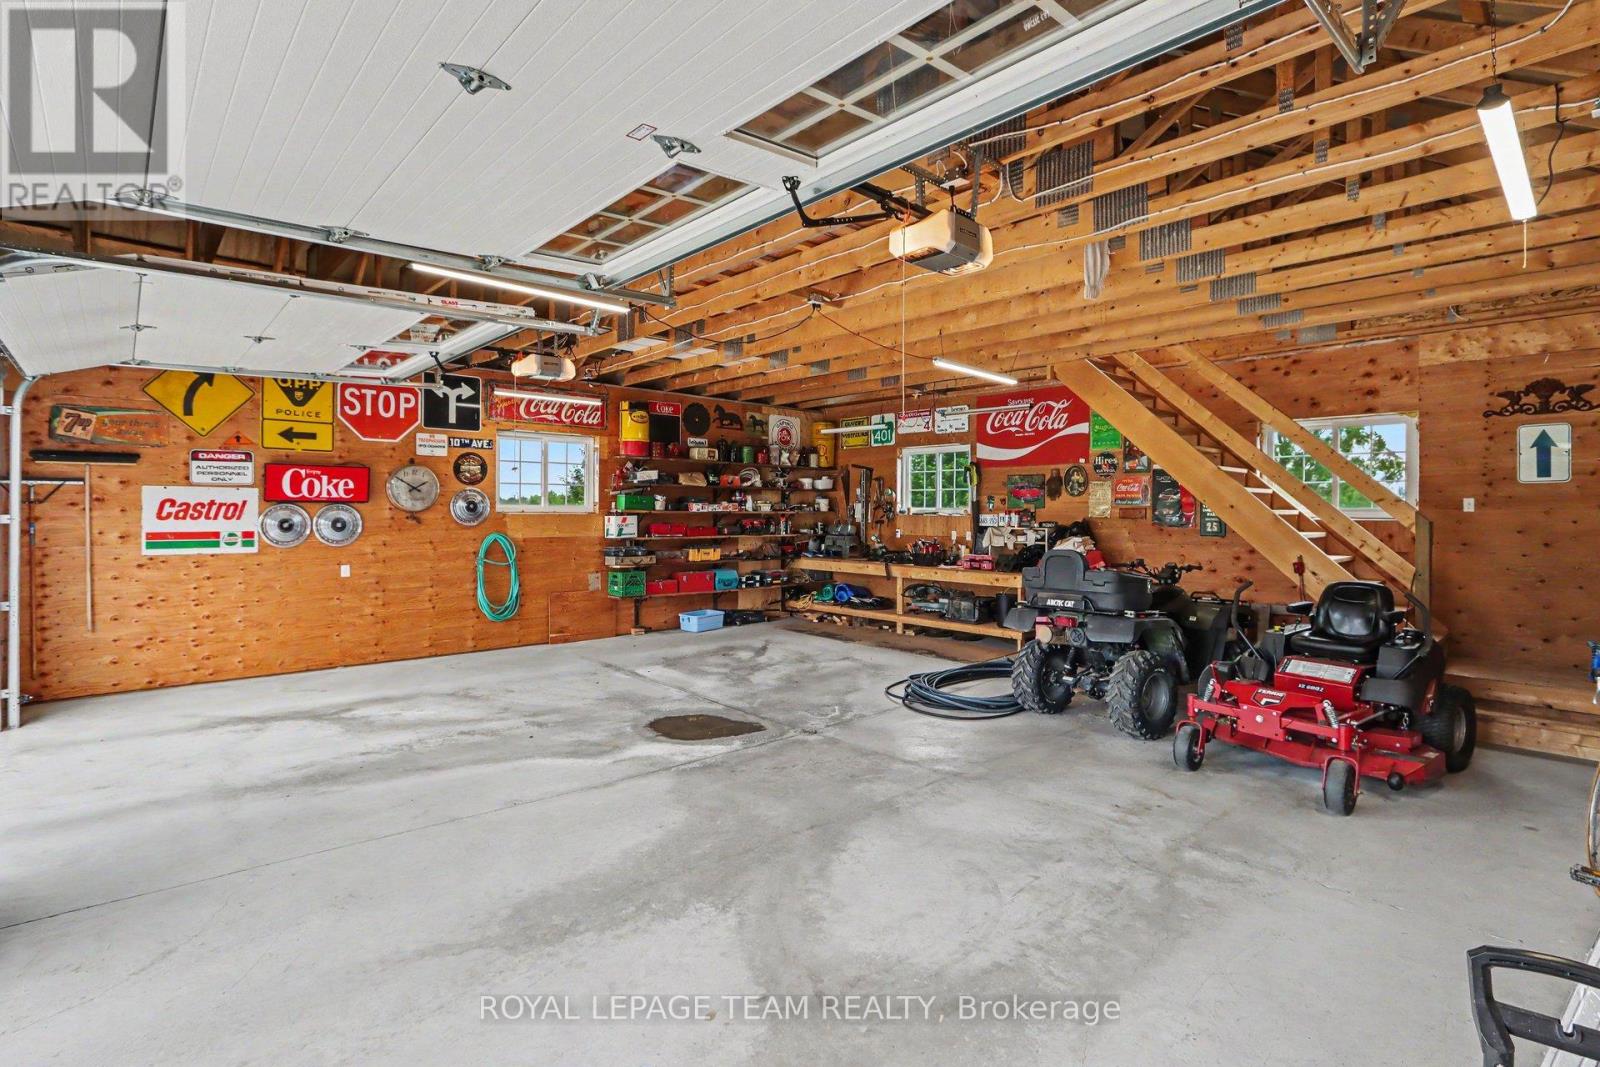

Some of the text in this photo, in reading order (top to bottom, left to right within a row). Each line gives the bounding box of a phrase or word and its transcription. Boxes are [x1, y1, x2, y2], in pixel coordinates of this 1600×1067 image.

[344, 387, 416, 418] STOP
[275, 409, 321, 418] POLICE
[986, 399, 1073, 434] Coca-Cola
[874, 429, 891, 442] 401
[198, 452, 246, 460] DANGER
[1095, 456, 1118, 465] Hires
[282, 468, 355, 498] Coke
[156, 498, 248, 521] Castrol
[1206, 522, 1218, 532] 25
[1046, 599, 1064, 607] ARCTIC
